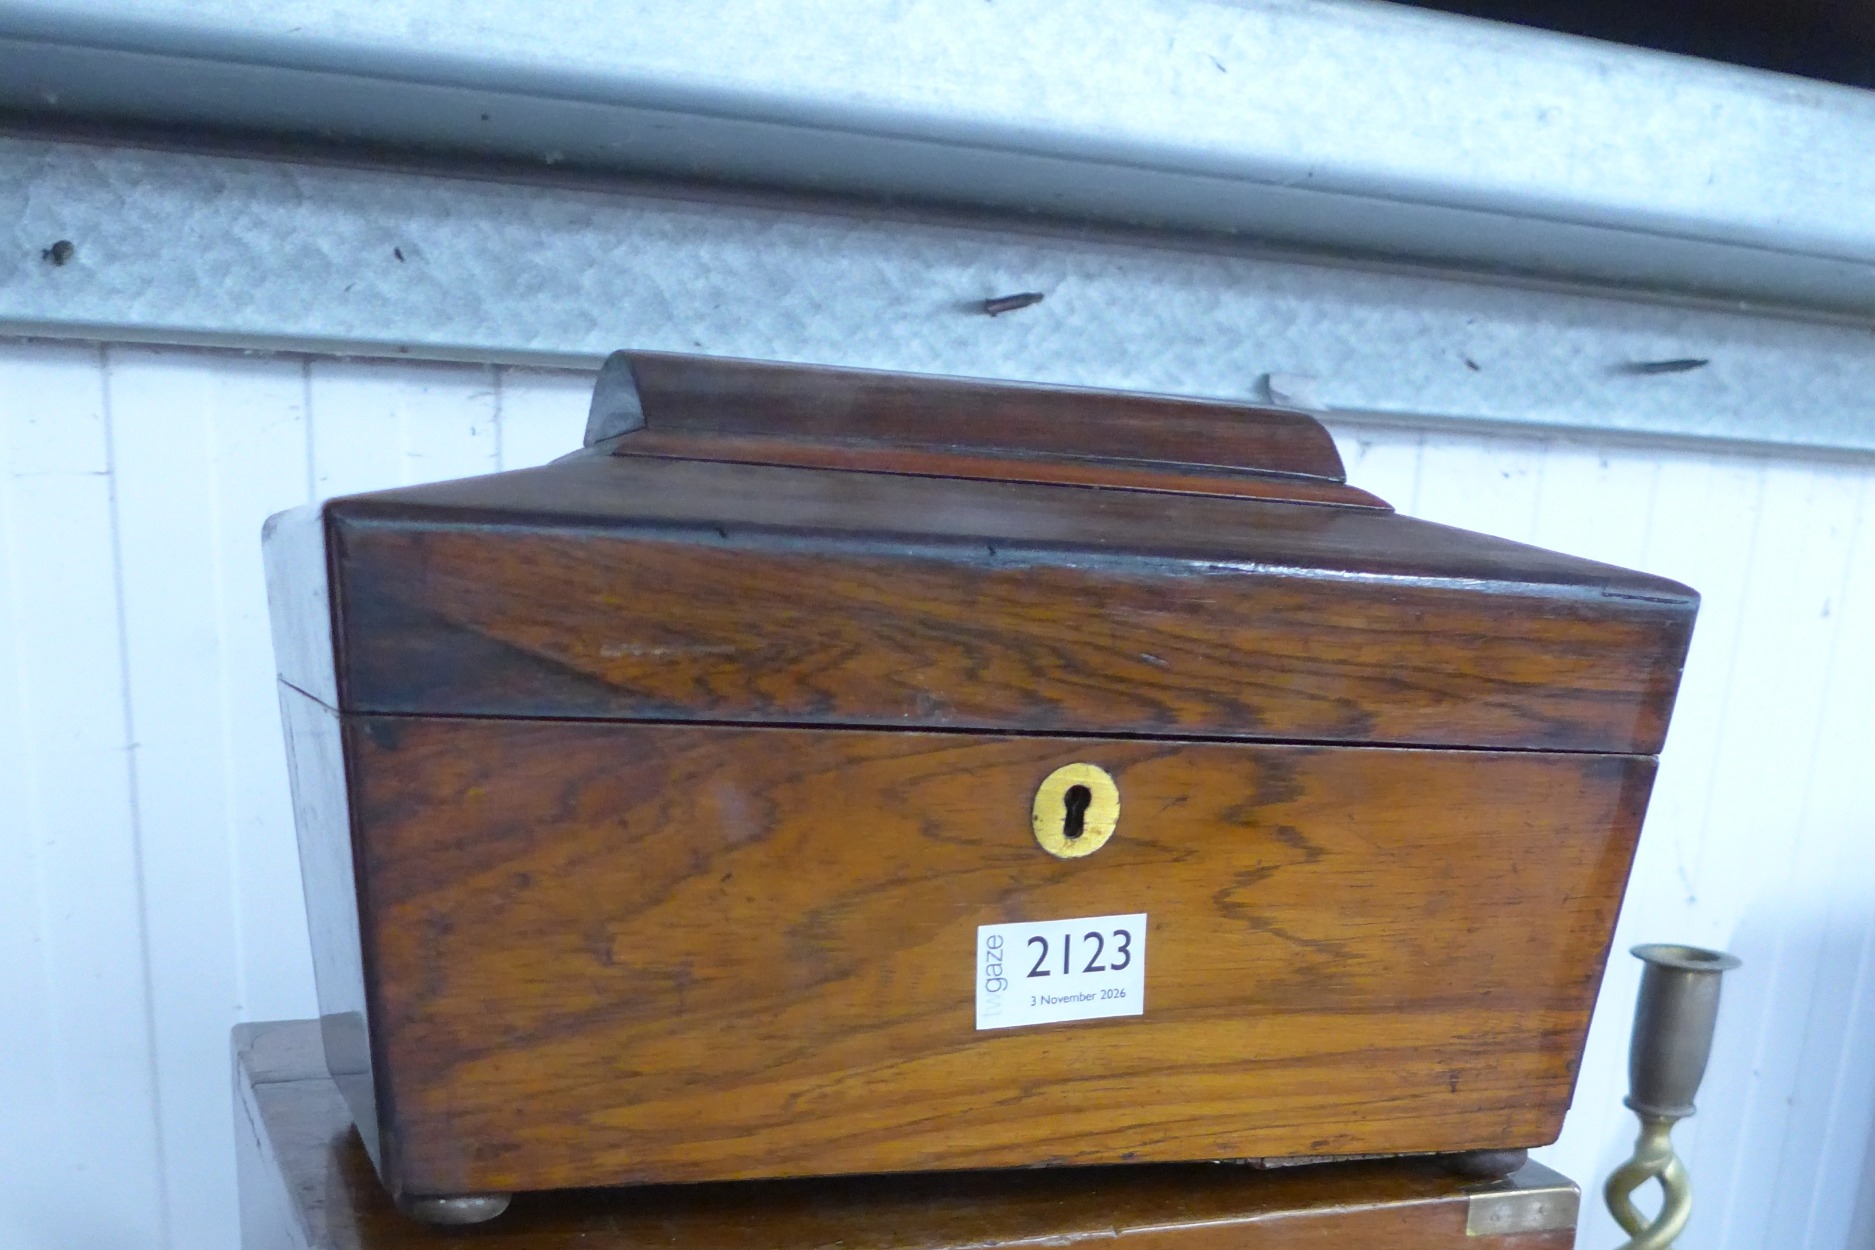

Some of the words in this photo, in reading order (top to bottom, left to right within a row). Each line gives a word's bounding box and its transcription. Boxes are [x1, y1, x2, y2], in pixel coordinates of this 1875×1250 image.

[1027, 929, 1132, 978] 2123
[1030, 996, 1037, 1007] 3
[1040, 992, 1097, 1006] November
[1100, 987, 1127, 1000] 2026
